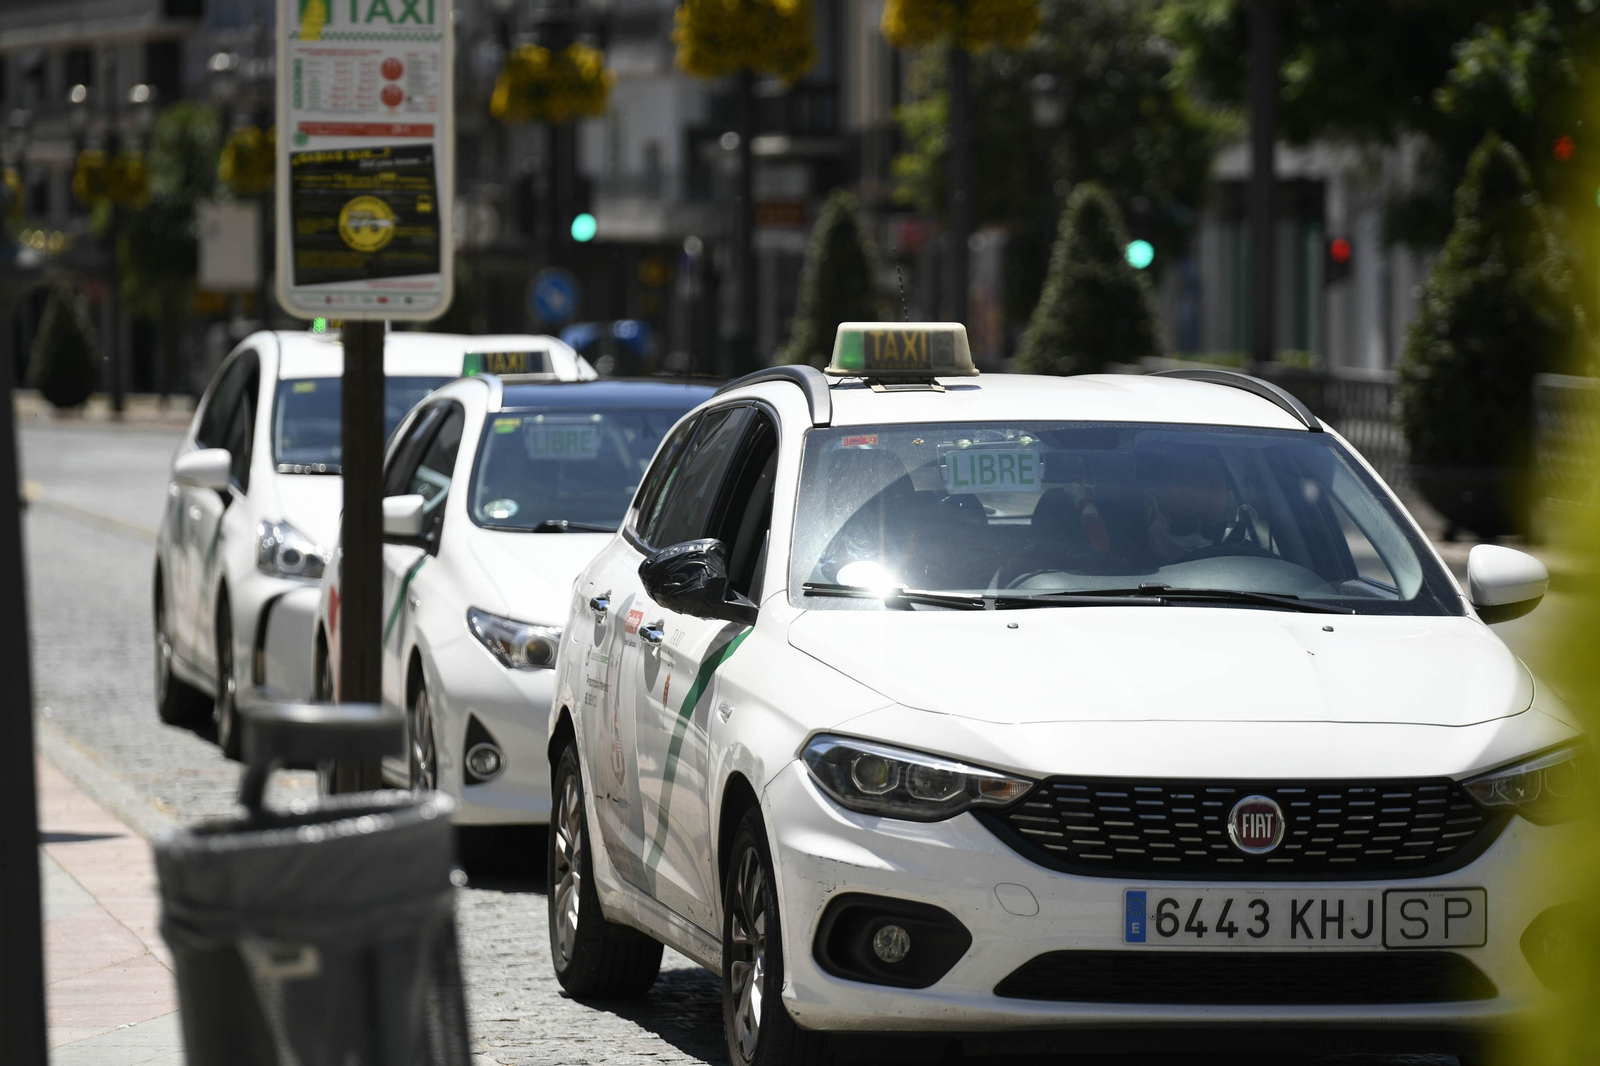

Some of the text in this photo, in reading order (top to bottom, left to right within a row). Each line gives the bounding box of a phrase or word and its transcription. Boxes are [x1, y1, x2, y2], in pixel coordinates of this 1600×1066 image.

[870, 330, 927, 361] TAXI
[487, 352, 526, 374] TAXI
[532, 430, 593, 454] LIBRE
[952, 453, 1035, 487] LIBRE
[1242, 813, 1274, 839] FIAT
[1131, 922, 1141, 934] E
[1155, 898, 1374, 940] 6443 KHJ
